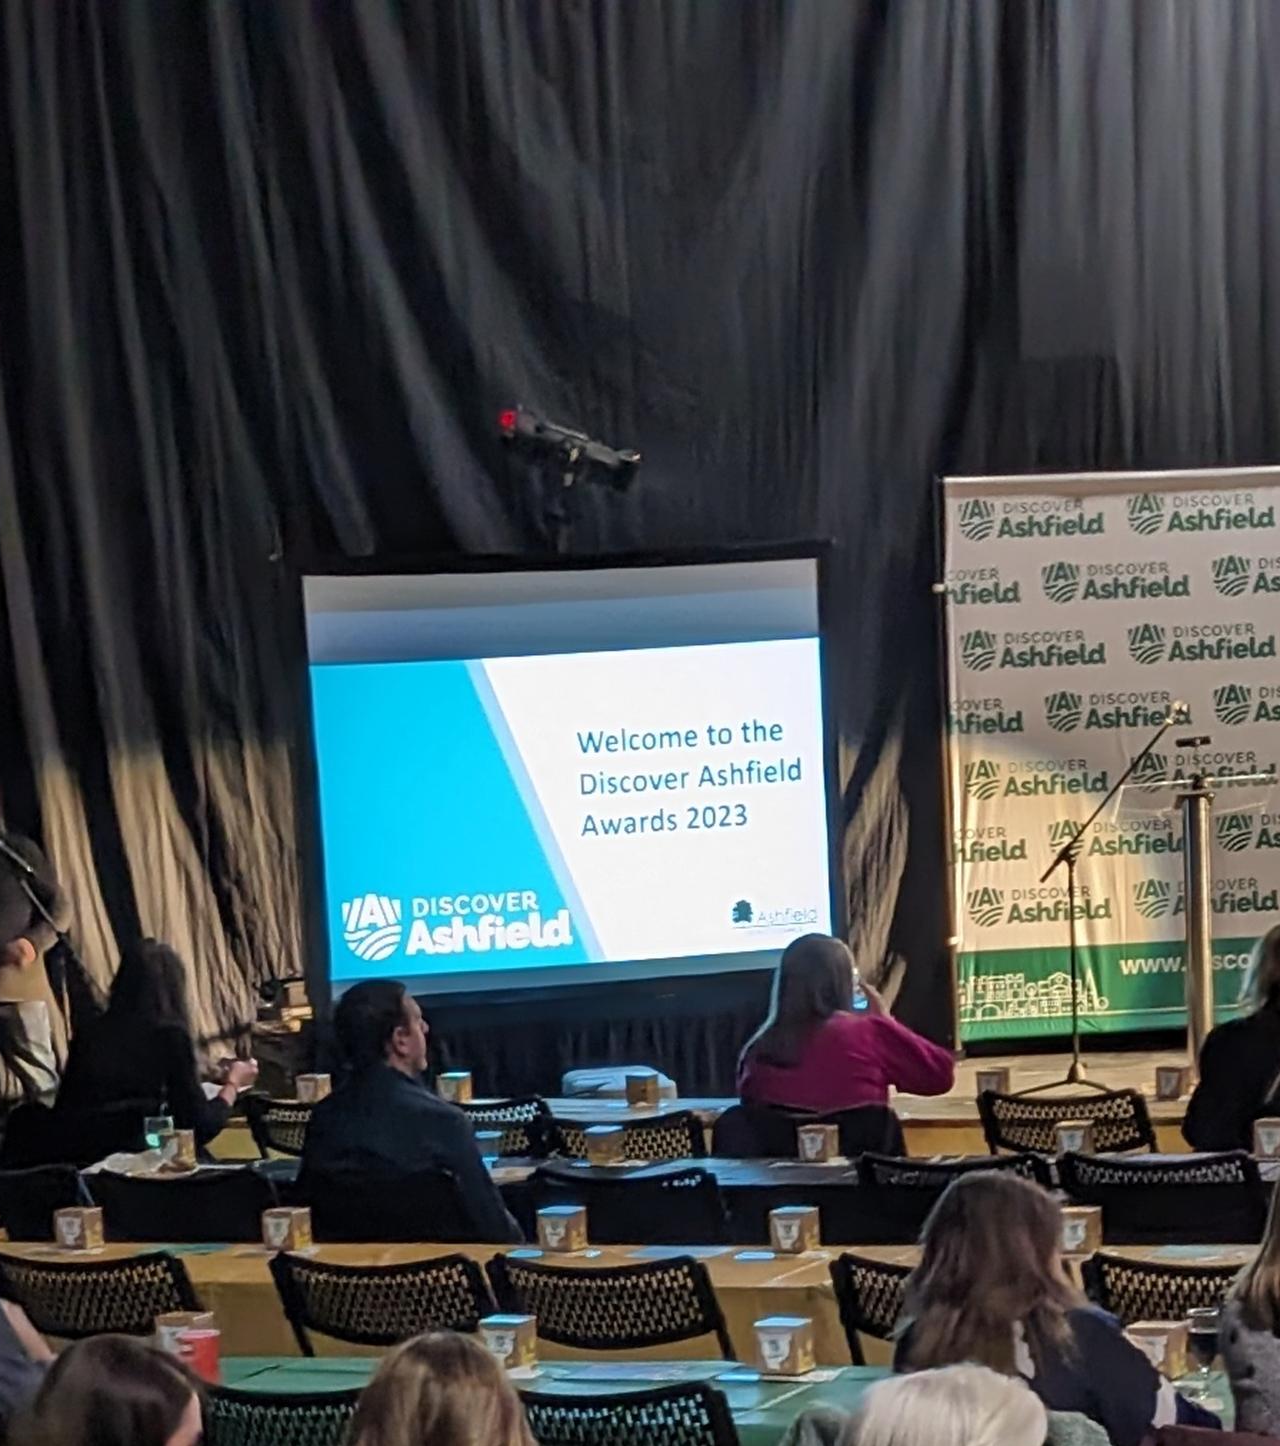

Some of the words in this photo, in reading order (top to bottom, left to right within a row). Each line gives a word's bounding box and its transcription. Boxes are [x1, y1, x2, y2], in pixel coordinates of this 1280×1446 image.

[1002, 500, 1084, 514] DISCOVER
[1172, 493, 1255, 508] DISCOVER
[996, 512, 1105, 538] Ashfield
[1167, 507, 1275, 533] Ashfield
[1086, 562, 1168, 576] DISCOVER
[1082, 575, 1190, 600] Ashfield
[1004, 630, 1085, 644] DISCOVER
[1173, 623, 1255, 639] DISCOVER
[999, 642, 1106, 669] Ashfield
[1167, 636, 1276, 662] Ashfield
[1089, 691, 1170, 705] DISCOVER
[1085, 704, 1192, 730] Ashfield
[577, 728, 698, 753] Welcome
[706, 724, 732, 746] to
[741, 718, 784, 743] the
[1008, 759, 1088, 773] DISCOVER
[1175, 751, 1256, 766] DISCOVER
[579, 771, 689, 795] Discover
[698, 757, 802, 787] Ashfield
[1003, 771, 1108, 797] Ashfield
[581, 808, 678, 836] Awards
[686, 803, 748, 829] 2023
[1093, 819, 1173, 834] DISCOVER
[411, 890, 539, 918] DISCOVER
[1011, 885, 1091, 900] DISCOVER
[1007, 897, 1112, 924] Ashfield
[404, 909, 574, 956] Ashfield
